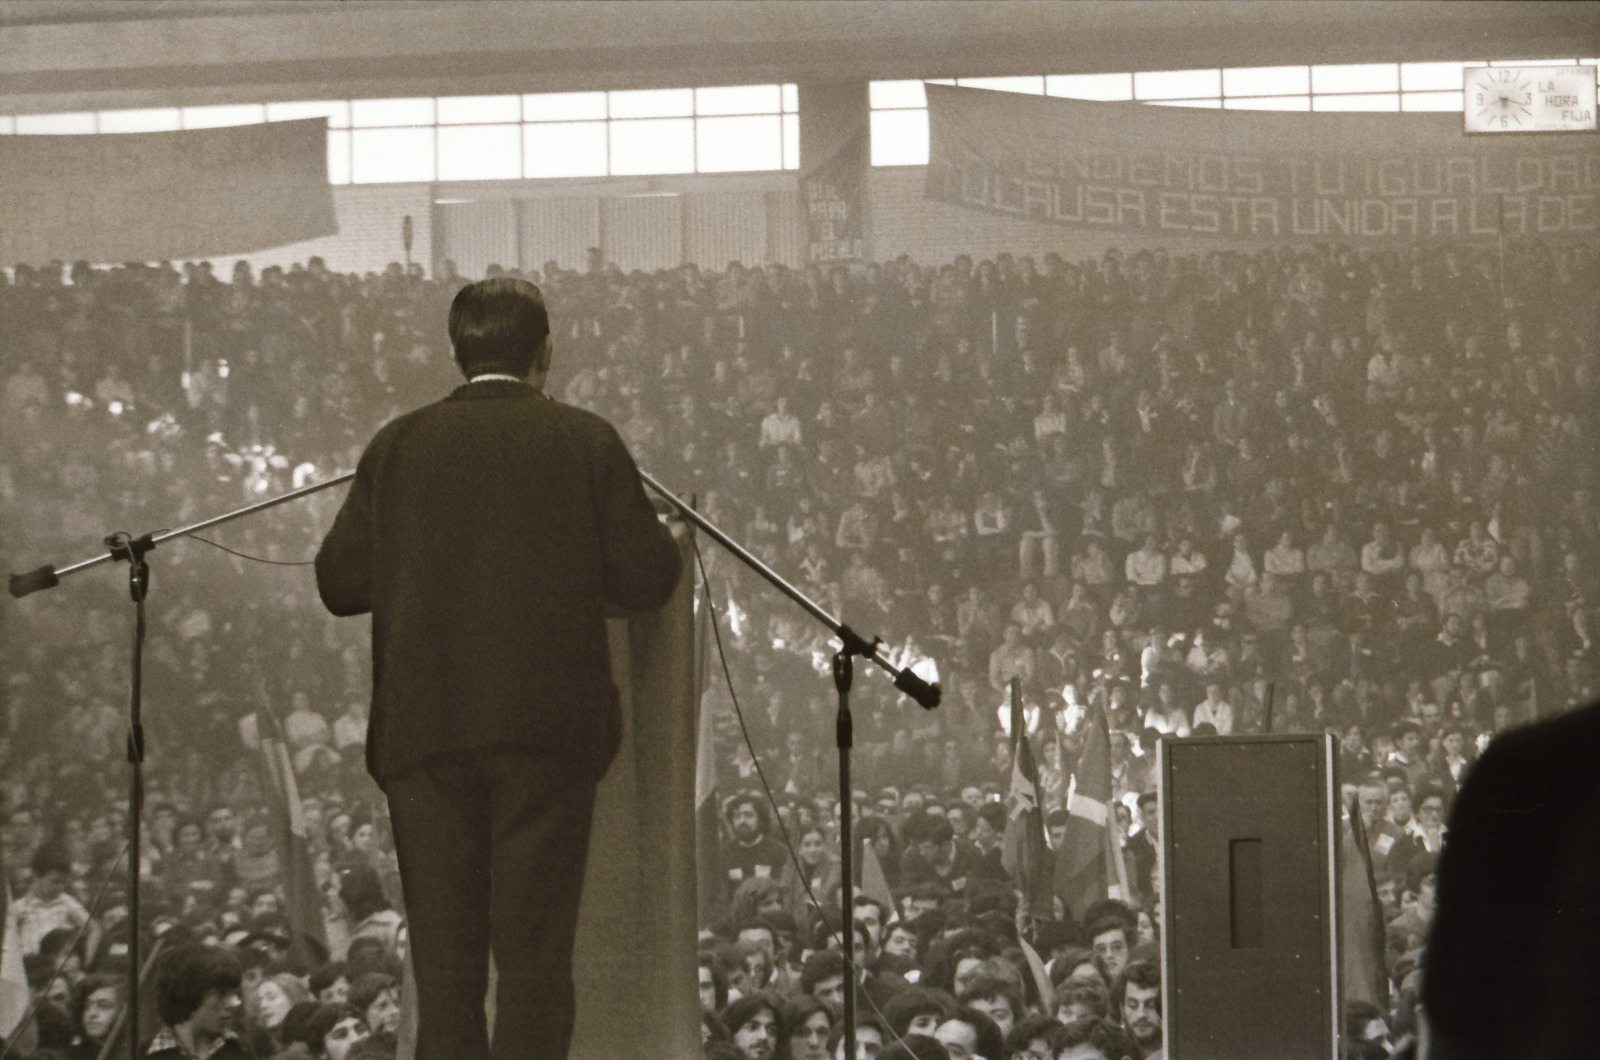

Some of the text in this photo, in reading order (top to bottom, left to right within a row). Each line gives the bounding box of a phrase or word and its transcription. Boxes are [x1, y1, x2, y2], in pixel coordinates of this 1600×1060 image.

[1498, 70, 1511, 84] 12
[1538, 81, 1555, 93] LA
[1476, 93, 1484, 106] 9
[1525, 92, 1532, 106] 3
[1545, 95, 1579, 107] HORA
[1501, 114, 1508, 128] 6
[1561, 110, 1592, 122] FIJA
[1159, 191, 1279, 236] ESTA
[1291, 198, 1418, 236] UNIDA
[1430, 198, 1458, 236] A
[1468, 196, 1527, 235] LA
